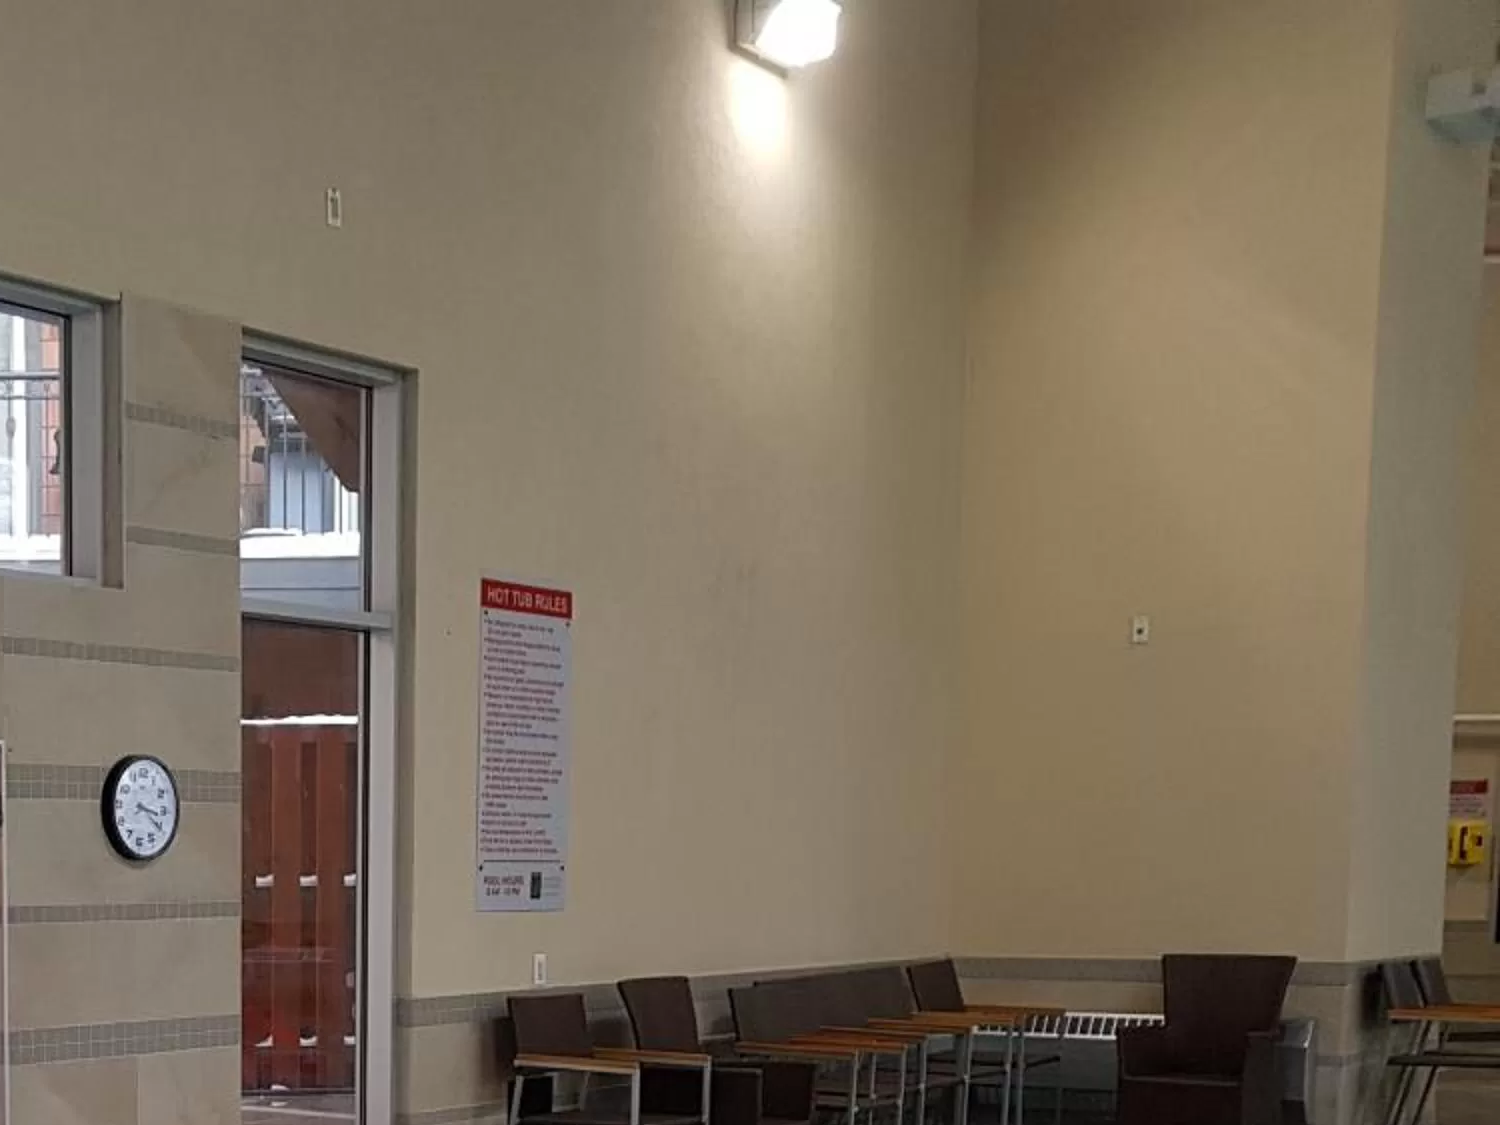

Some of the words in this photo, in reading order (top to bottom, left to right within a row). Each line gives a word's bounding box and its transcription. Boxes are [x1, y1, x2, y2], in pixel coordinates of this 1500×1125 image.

[487, 584, 510, 606] HOT
[511, 589, 533, 609] TUB
[534, 592, 568, 614] RULES
